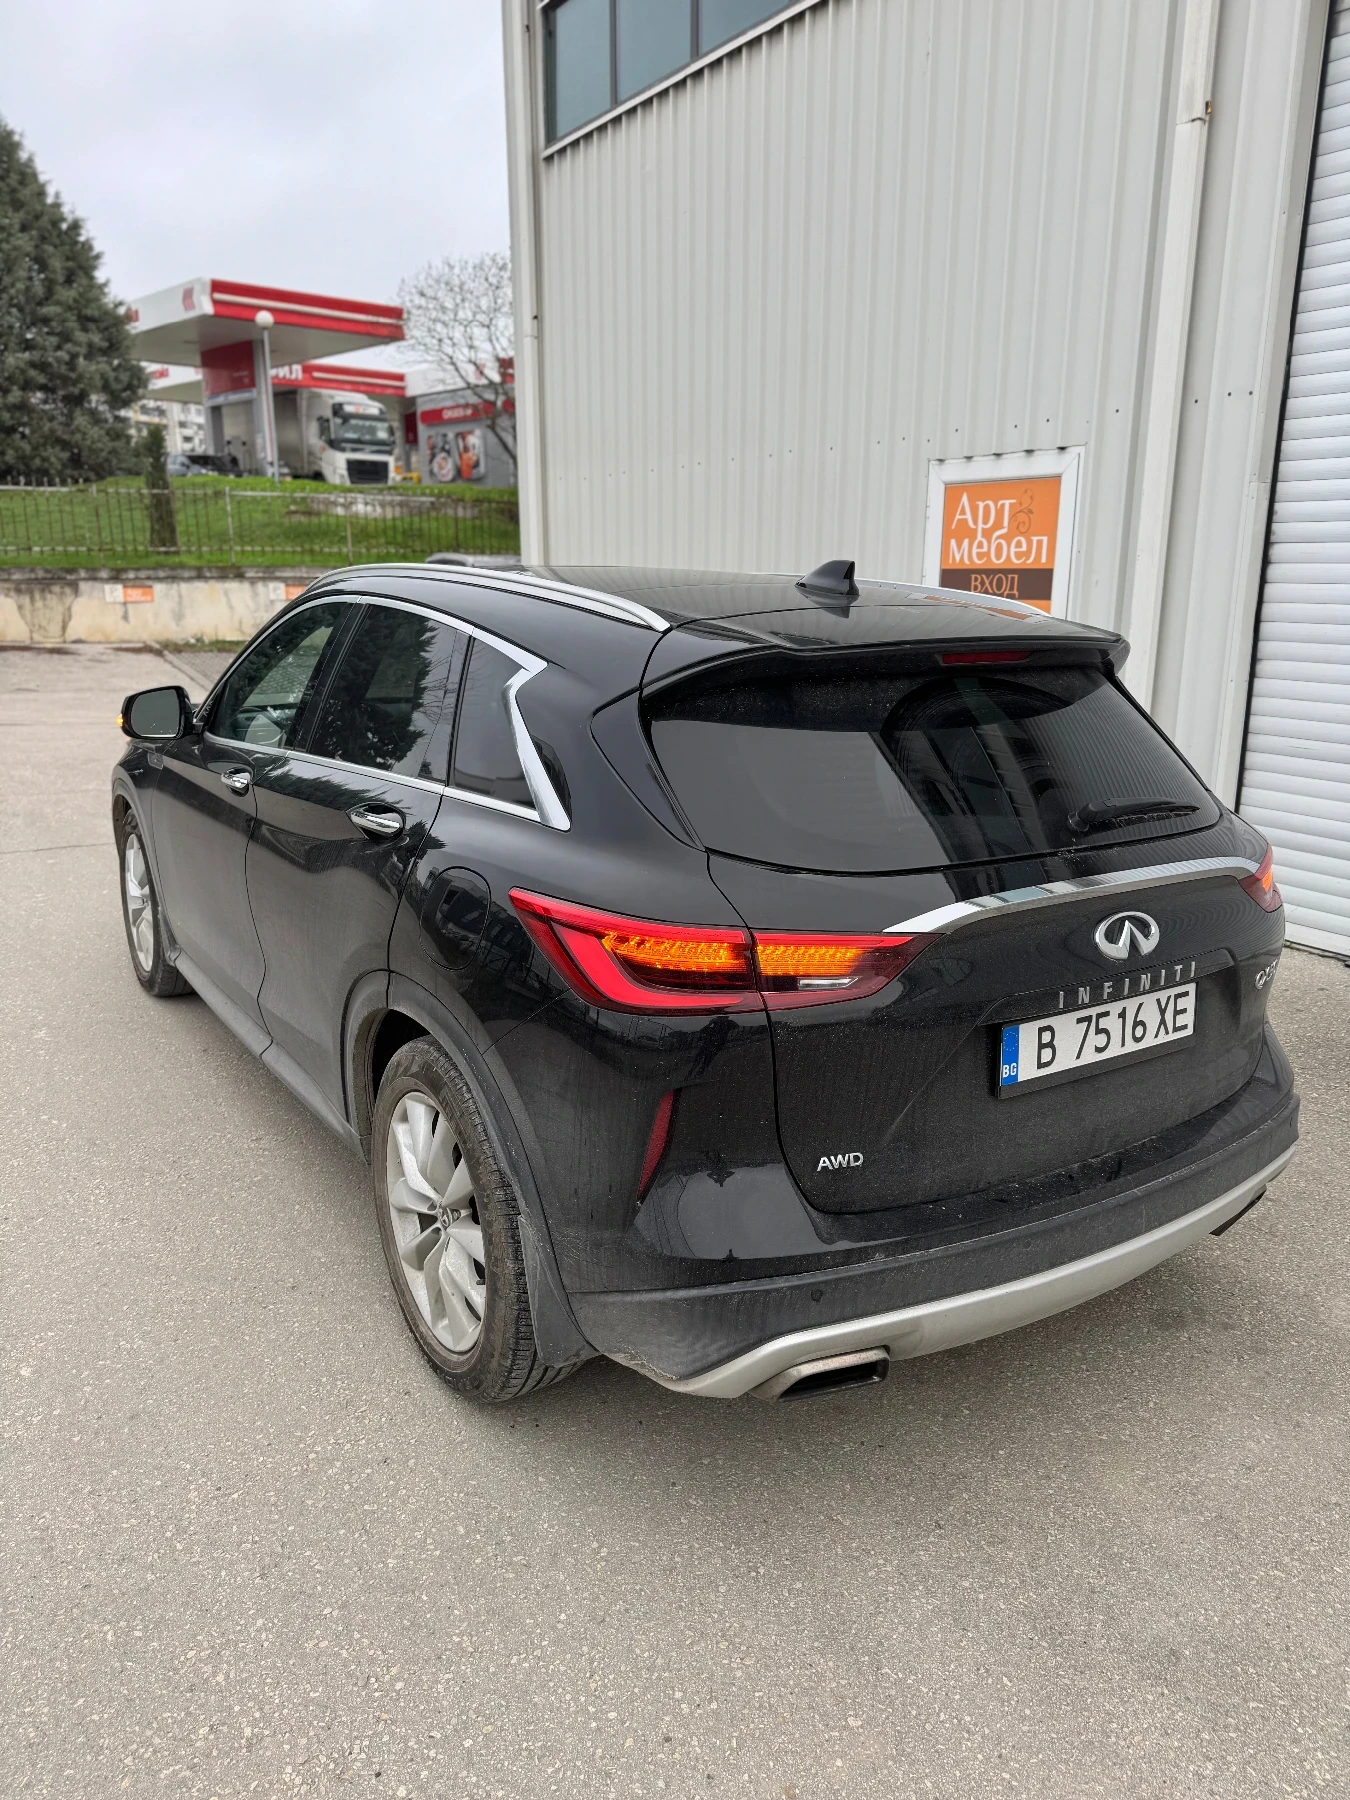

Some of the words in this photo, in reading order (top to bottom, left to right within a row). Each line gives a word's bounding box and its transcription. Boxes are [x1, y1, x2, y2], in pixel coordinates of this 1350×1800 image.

[952, 492, 1016, 540] Арт
[949, 527, 1048, 564] мебел
[970, 573, 1018, 598] ВХОД
[1059, 961, 1196, 1008] INFINITI
[1037, 1025, 1056, 1069] B
[1075, 1002, 1147, 1061] 7516
[1154, 990, 1190, 1038] XE
[1002, 1063, 1017, 1077] BG
[817, 1152, 863, 1171] AWD
